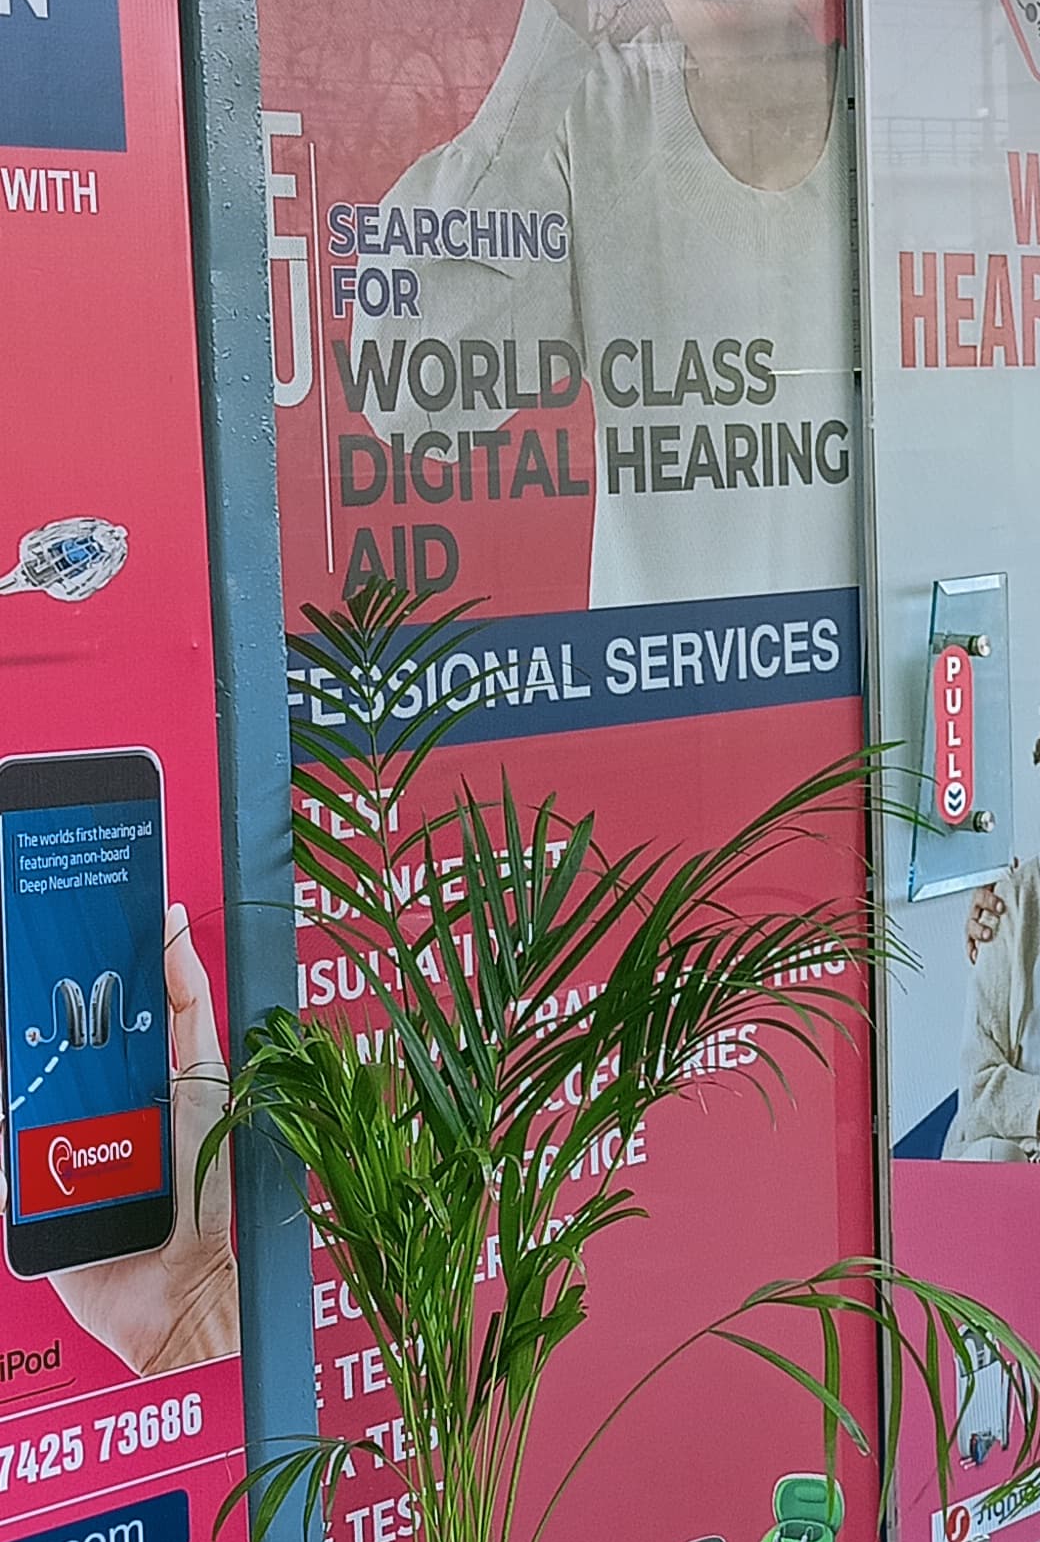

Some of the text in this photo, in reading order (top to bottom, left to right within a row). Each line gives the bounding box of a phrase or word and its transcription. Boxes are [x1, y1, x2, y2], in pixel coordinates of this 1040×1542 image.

[0, 167, 98, 214] WITH
[328, 204, 568, 260] SEARCHING
[333, 267, 421, 318] FOR
[332, 338, 777, 413] WORLD CLASS
[337, 419, 851, 508] DIGITAL HEARING
[341, 523, 460, 601] AID
[605, 617, 840, 696] SERVICES
[944, 655, 963, 779] PULL
[17, 820, 152, 848] The worlds first hearing aid
[301, 787, 404, 841] TEST
[19, 844, 130, 871] featuring an on-board
[19, 867, 129, 895] Deep Neural Network
[93, 1392, 203, 1463] 73686
